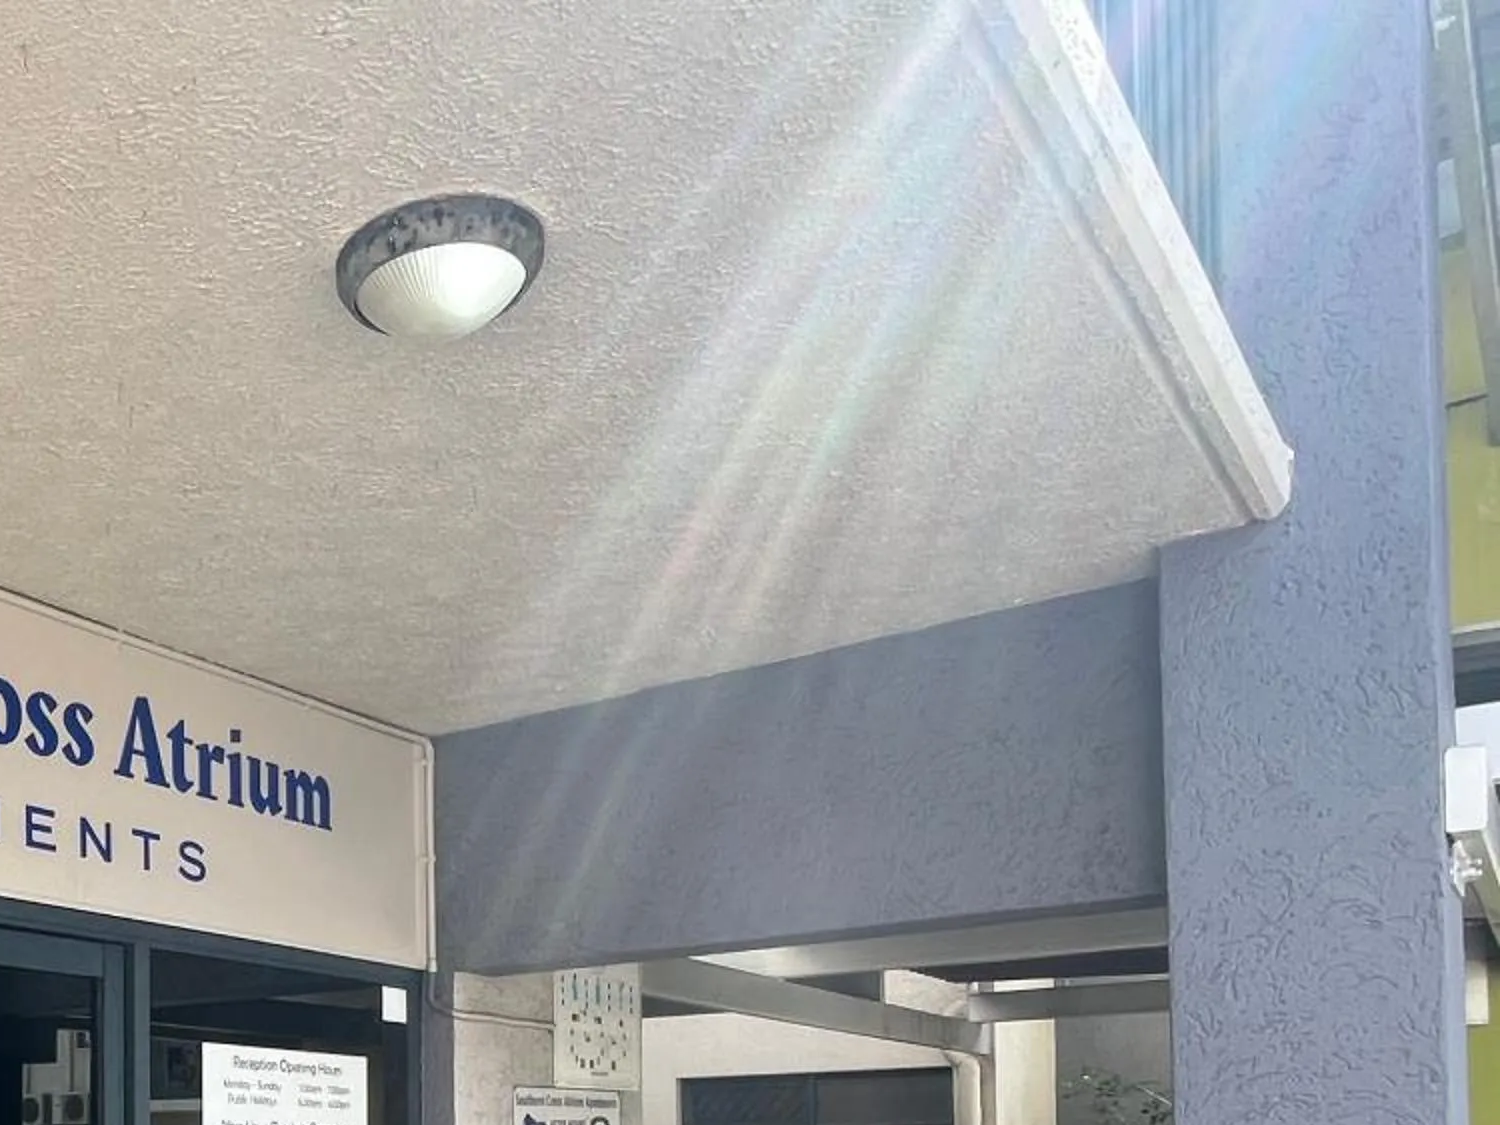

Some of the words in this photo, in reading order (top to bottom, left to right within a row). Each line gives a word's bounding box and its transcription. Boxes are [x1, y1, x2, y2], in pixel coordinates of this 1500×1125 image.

[113, 696, 333, 833] Atrium
[233, 1055, 278, 1072] Reception
[279, 1059, 316, 1076] Opening
